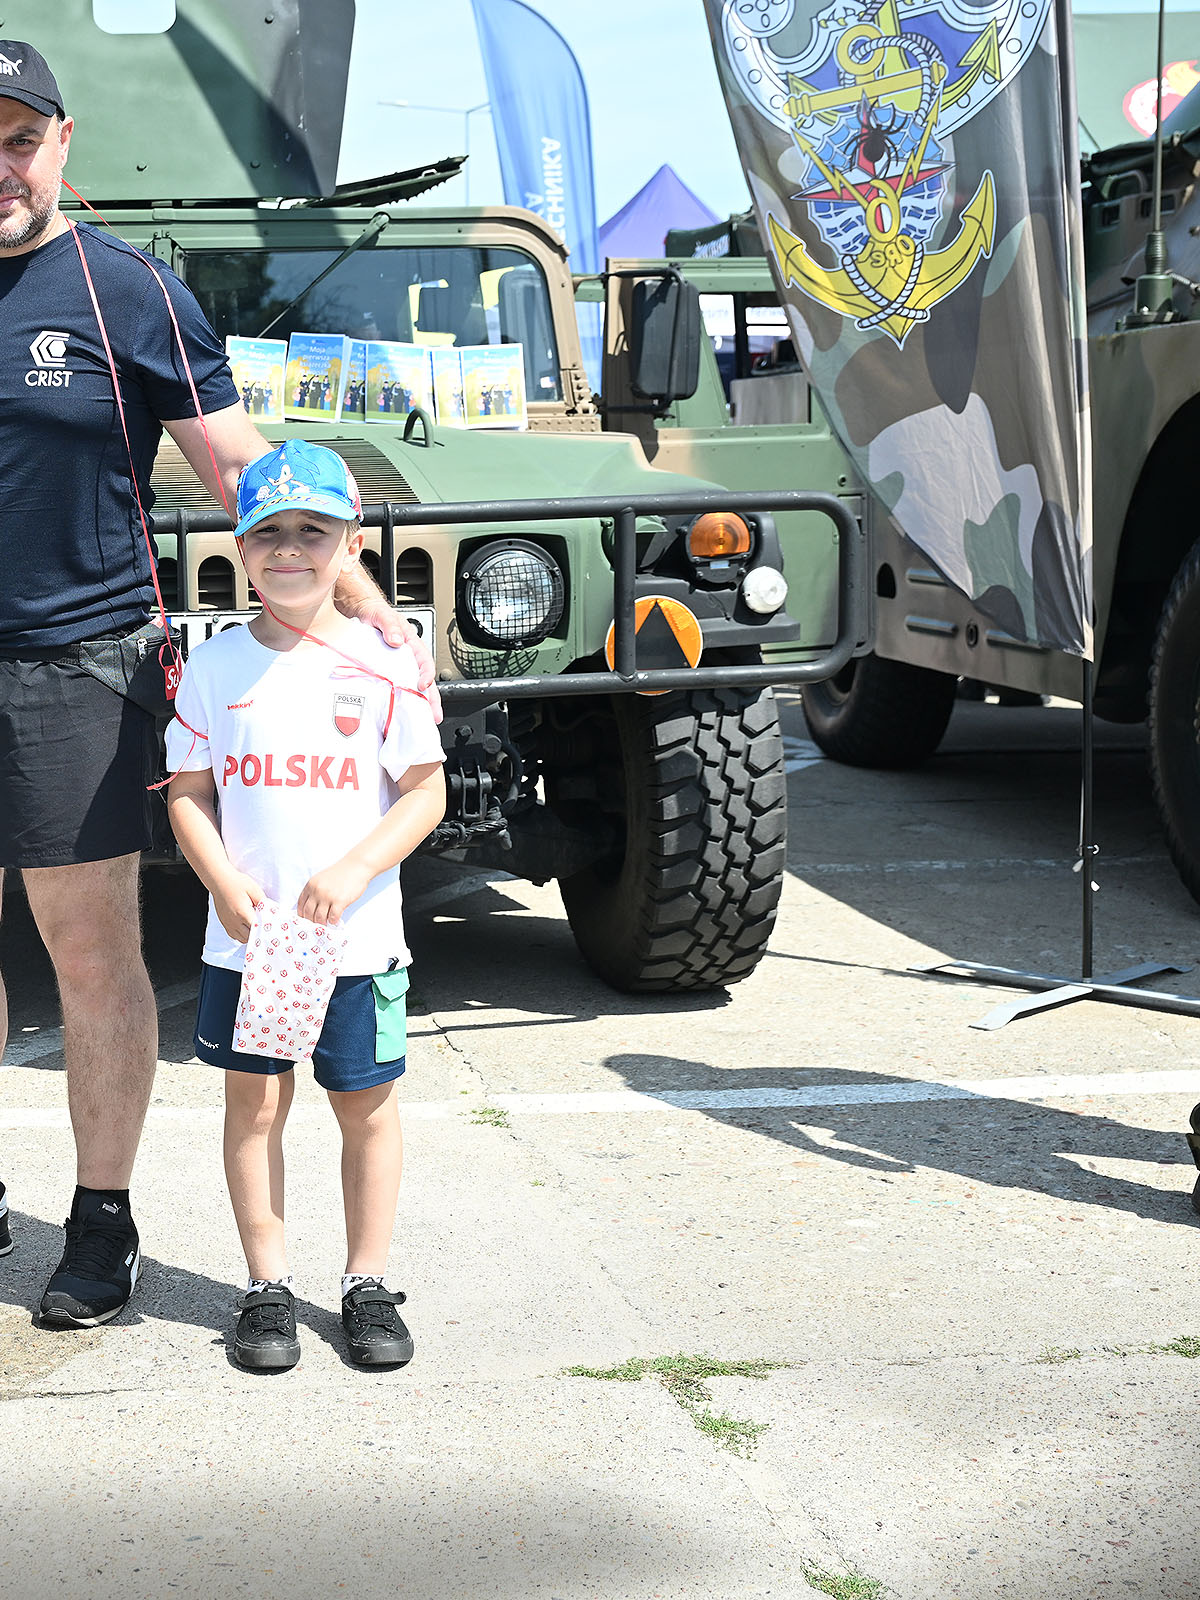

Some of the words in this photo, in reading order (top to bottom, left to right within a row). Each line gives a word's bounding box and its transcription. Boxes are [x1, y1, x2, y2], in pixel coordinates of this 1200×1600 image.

[24, 369, 74, 388] CRIST
[337, 695, 363, 705] POLSKA
[222, 753, 360, 791] POLSKA
